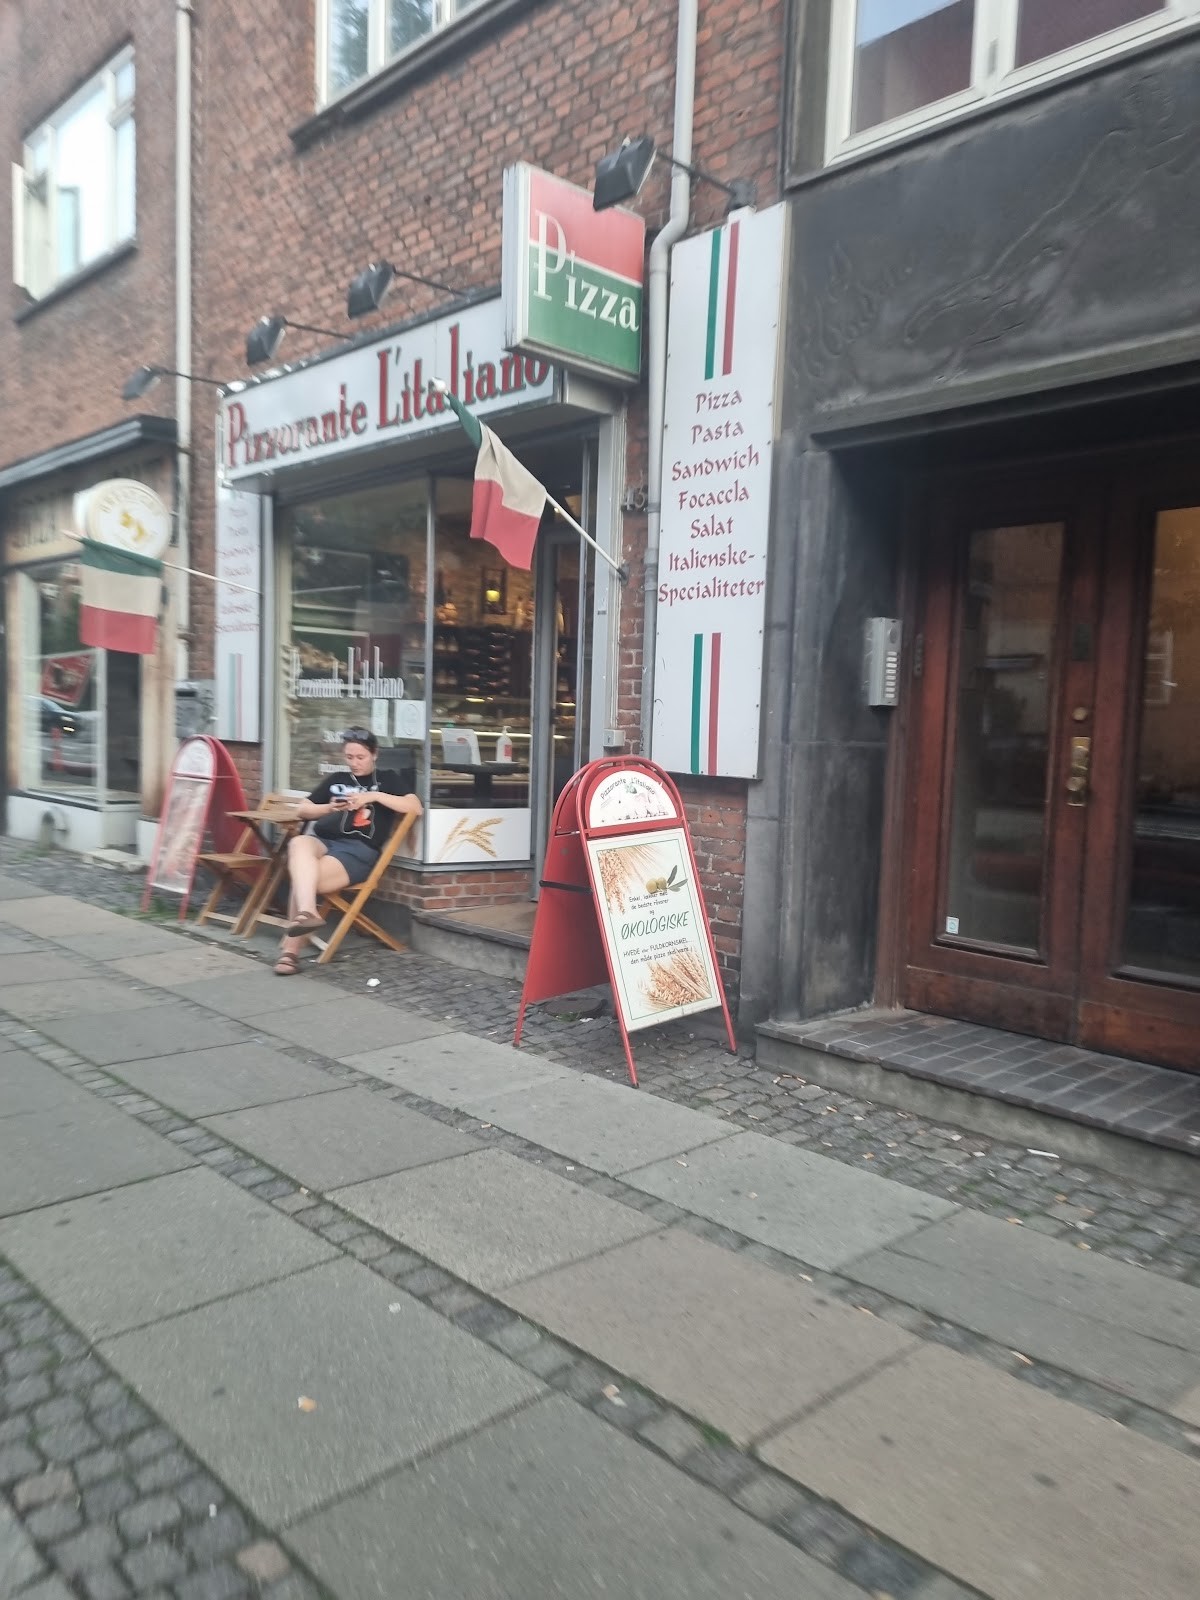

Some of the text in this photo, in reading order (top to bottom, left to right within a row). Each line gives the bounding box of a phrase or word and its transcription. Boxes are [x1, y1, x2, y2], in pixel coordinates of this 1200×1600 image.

[533, 209, 639, 332] Pizza
[227, 320, 550, 470] Pizzorante L'italiano
[695, 389, 743, 413] Pizza
[691, 420, 745, 445] Pasta
[671, 444, 760, 481] Sandwich
[690, 513, 734, 539] Salat
[668, 543, 755, 572] Italienske-
[658, 576, 766, 606] Specialiteter
[621, 910, 689, 940] ØKOLOGISKE
[623, 948, 641, 957] HVEDE
